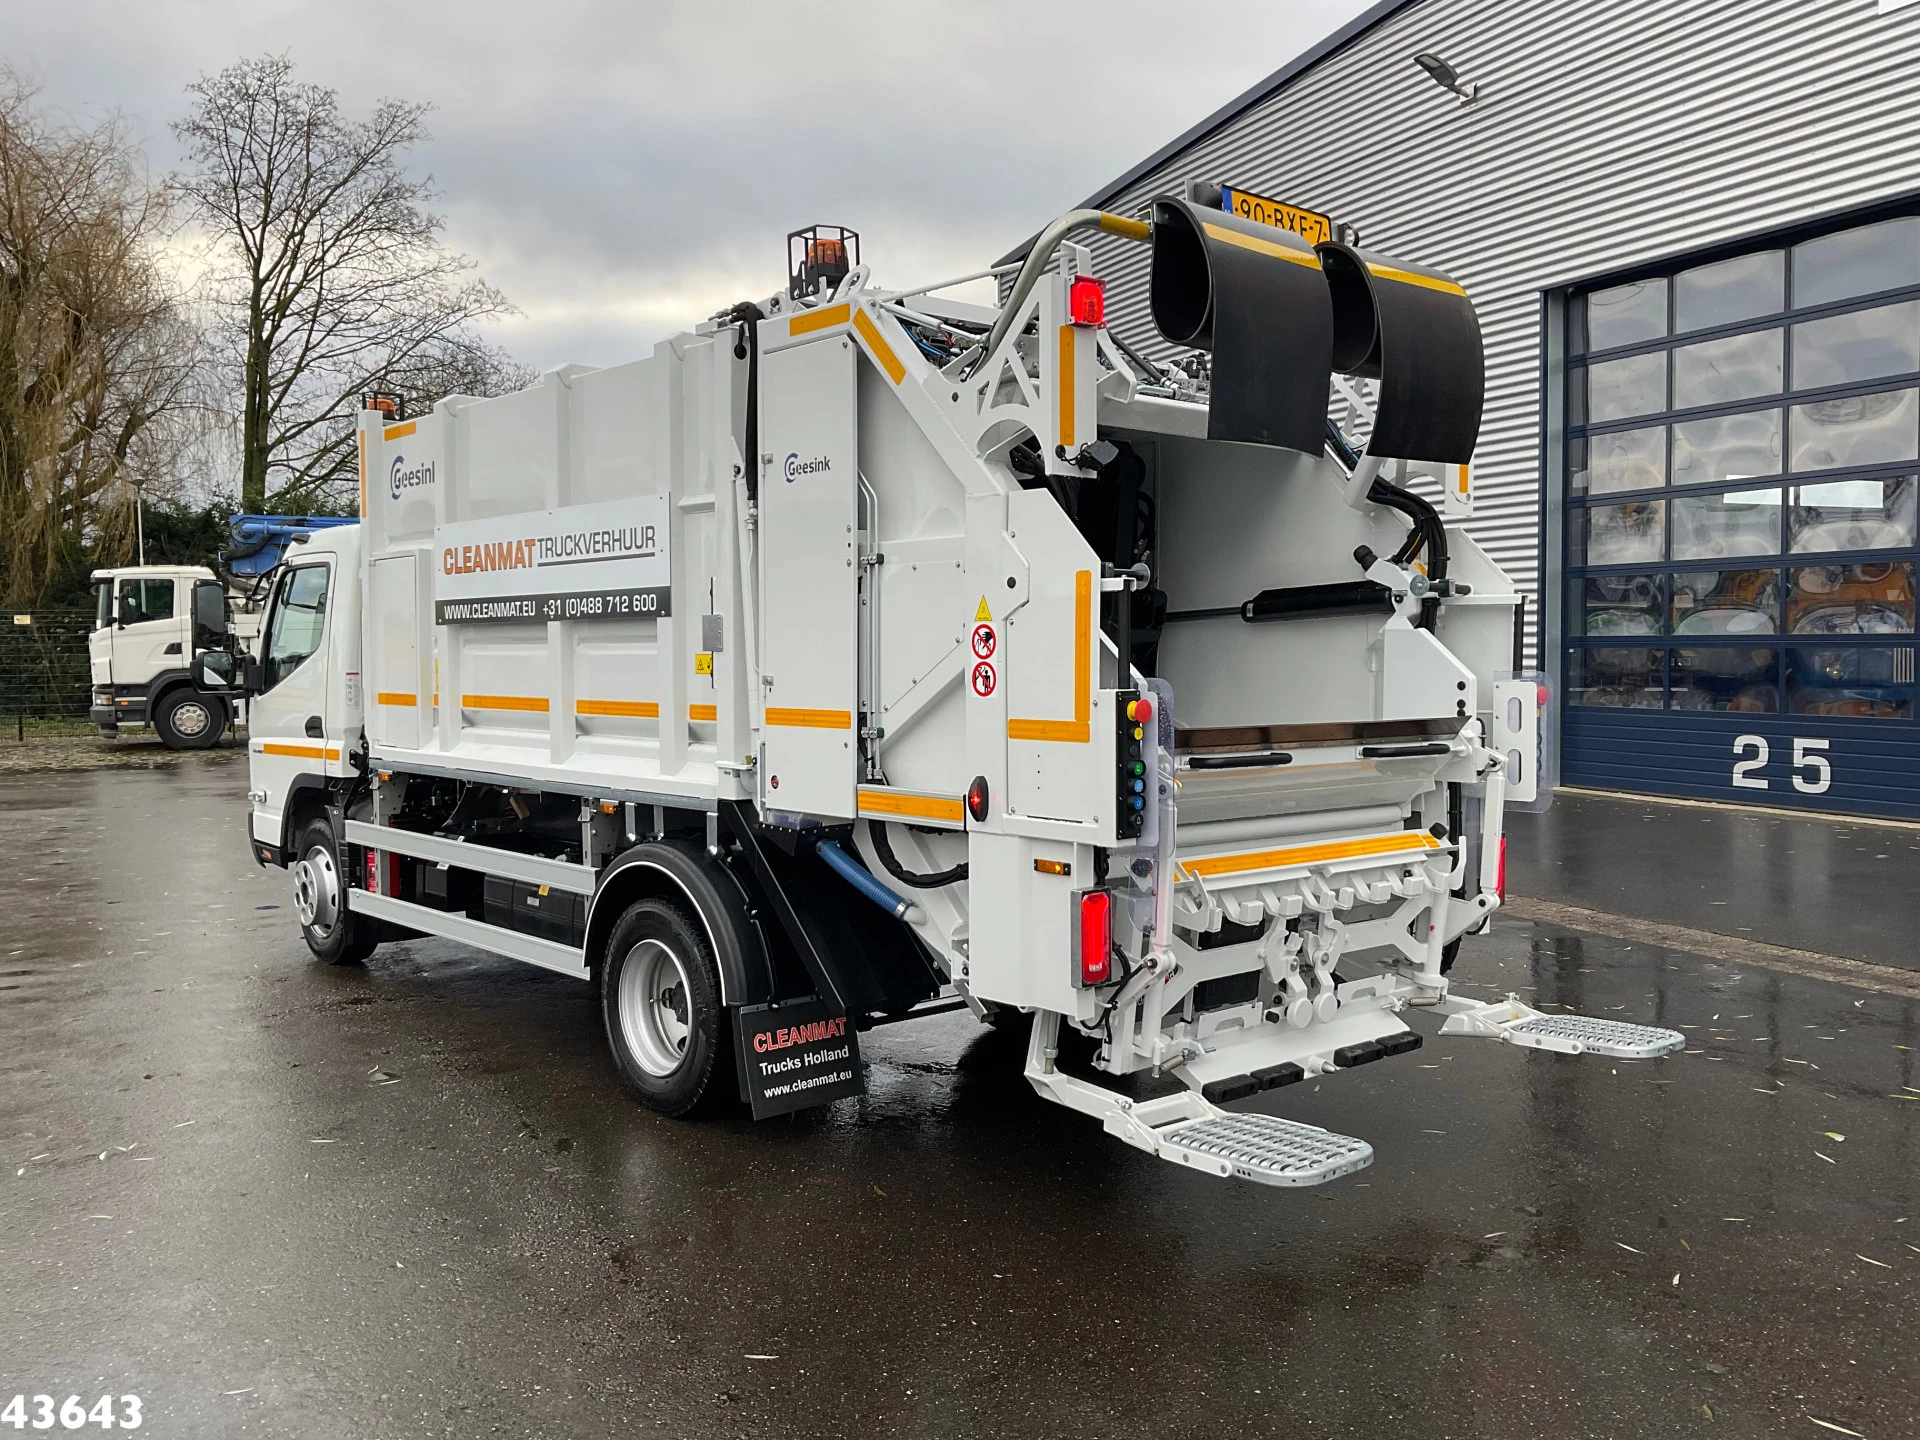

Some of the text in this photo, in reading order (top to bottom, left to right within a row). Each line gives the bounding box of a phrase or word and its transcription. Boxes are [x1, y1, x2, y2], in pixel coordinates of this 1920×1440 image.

[785, 453, 831, 481] Geesink
[444, 594, 657, 620] WWW.CLEANMAT.EU +31 (0)488 712 600
[753, 1016, 847, 1053] CLEANMAT
[759, 1044, 850, 1076] Trucks Holland
[763, 1070, 853, 1098] www.cleanmat.eu
